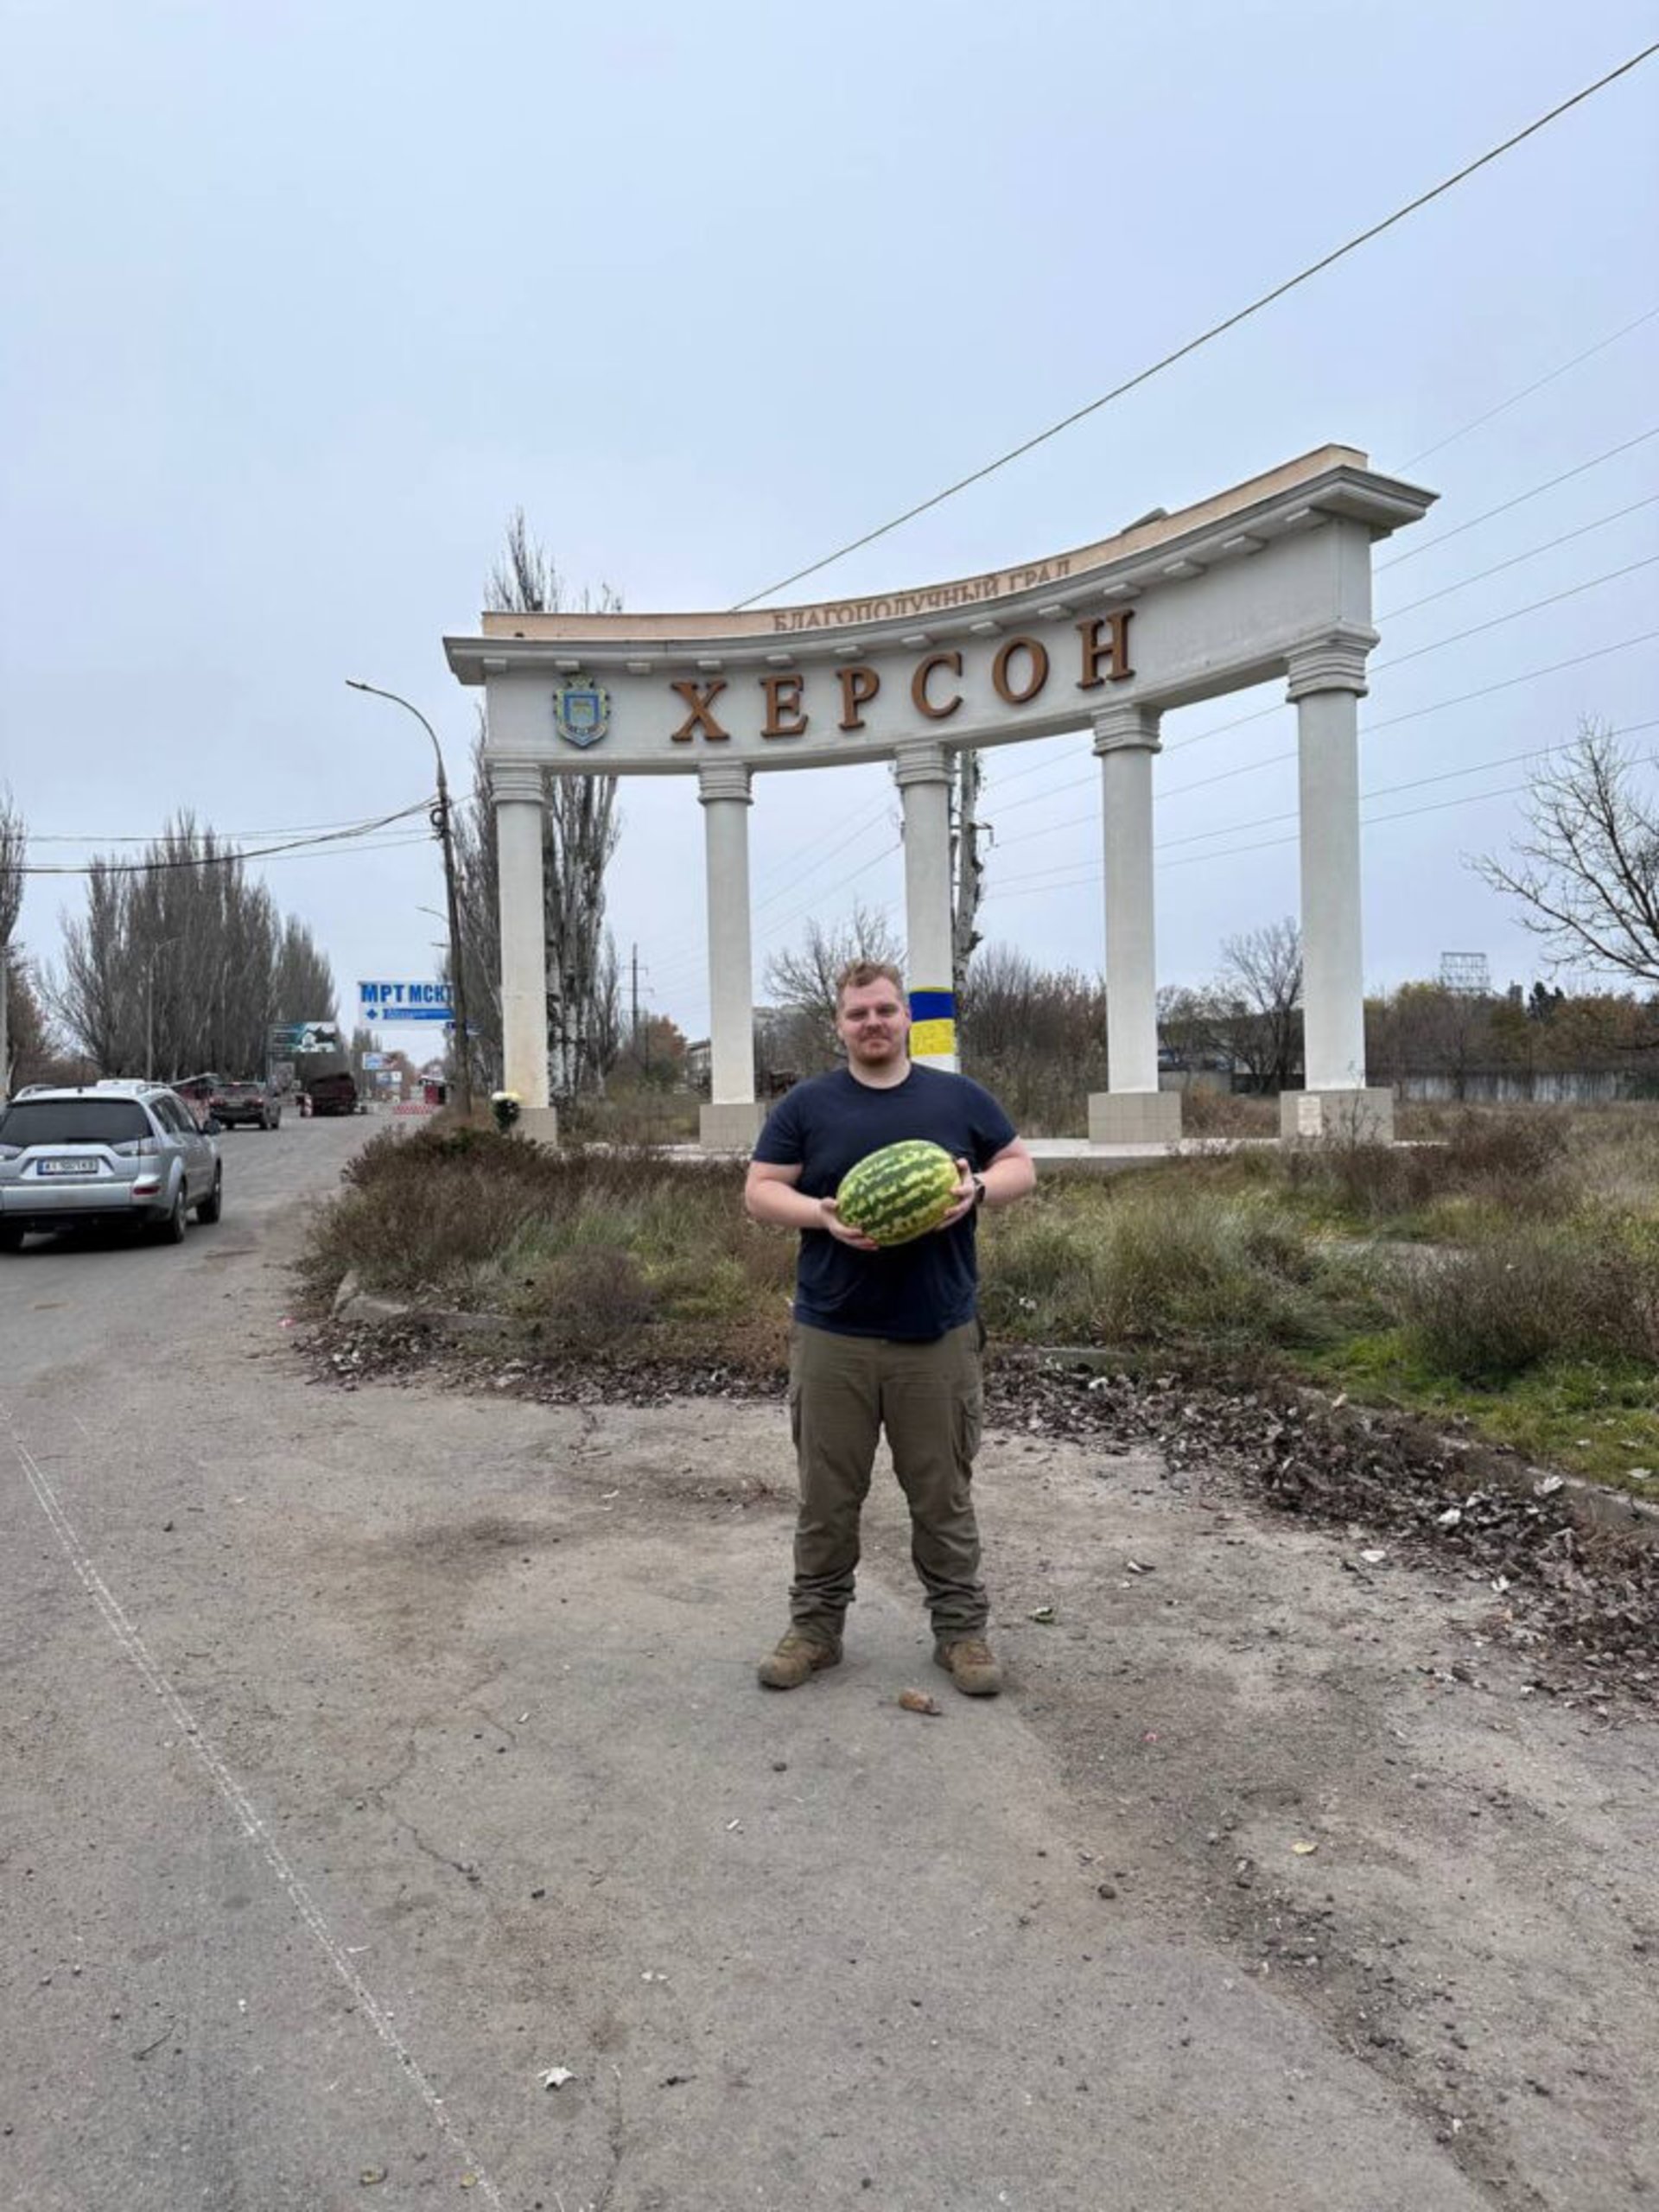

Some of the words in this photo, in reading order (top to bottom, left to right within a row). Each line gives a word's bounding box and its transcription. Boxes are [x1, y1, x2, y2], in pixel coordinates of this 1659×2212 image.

[772, 575, 1000, 632] БЛАГОПОЛУЧНЫЙ
[671, 609, 1135, 741] ХЕРСОН
[360, 984, 404, 1003] МРТ
